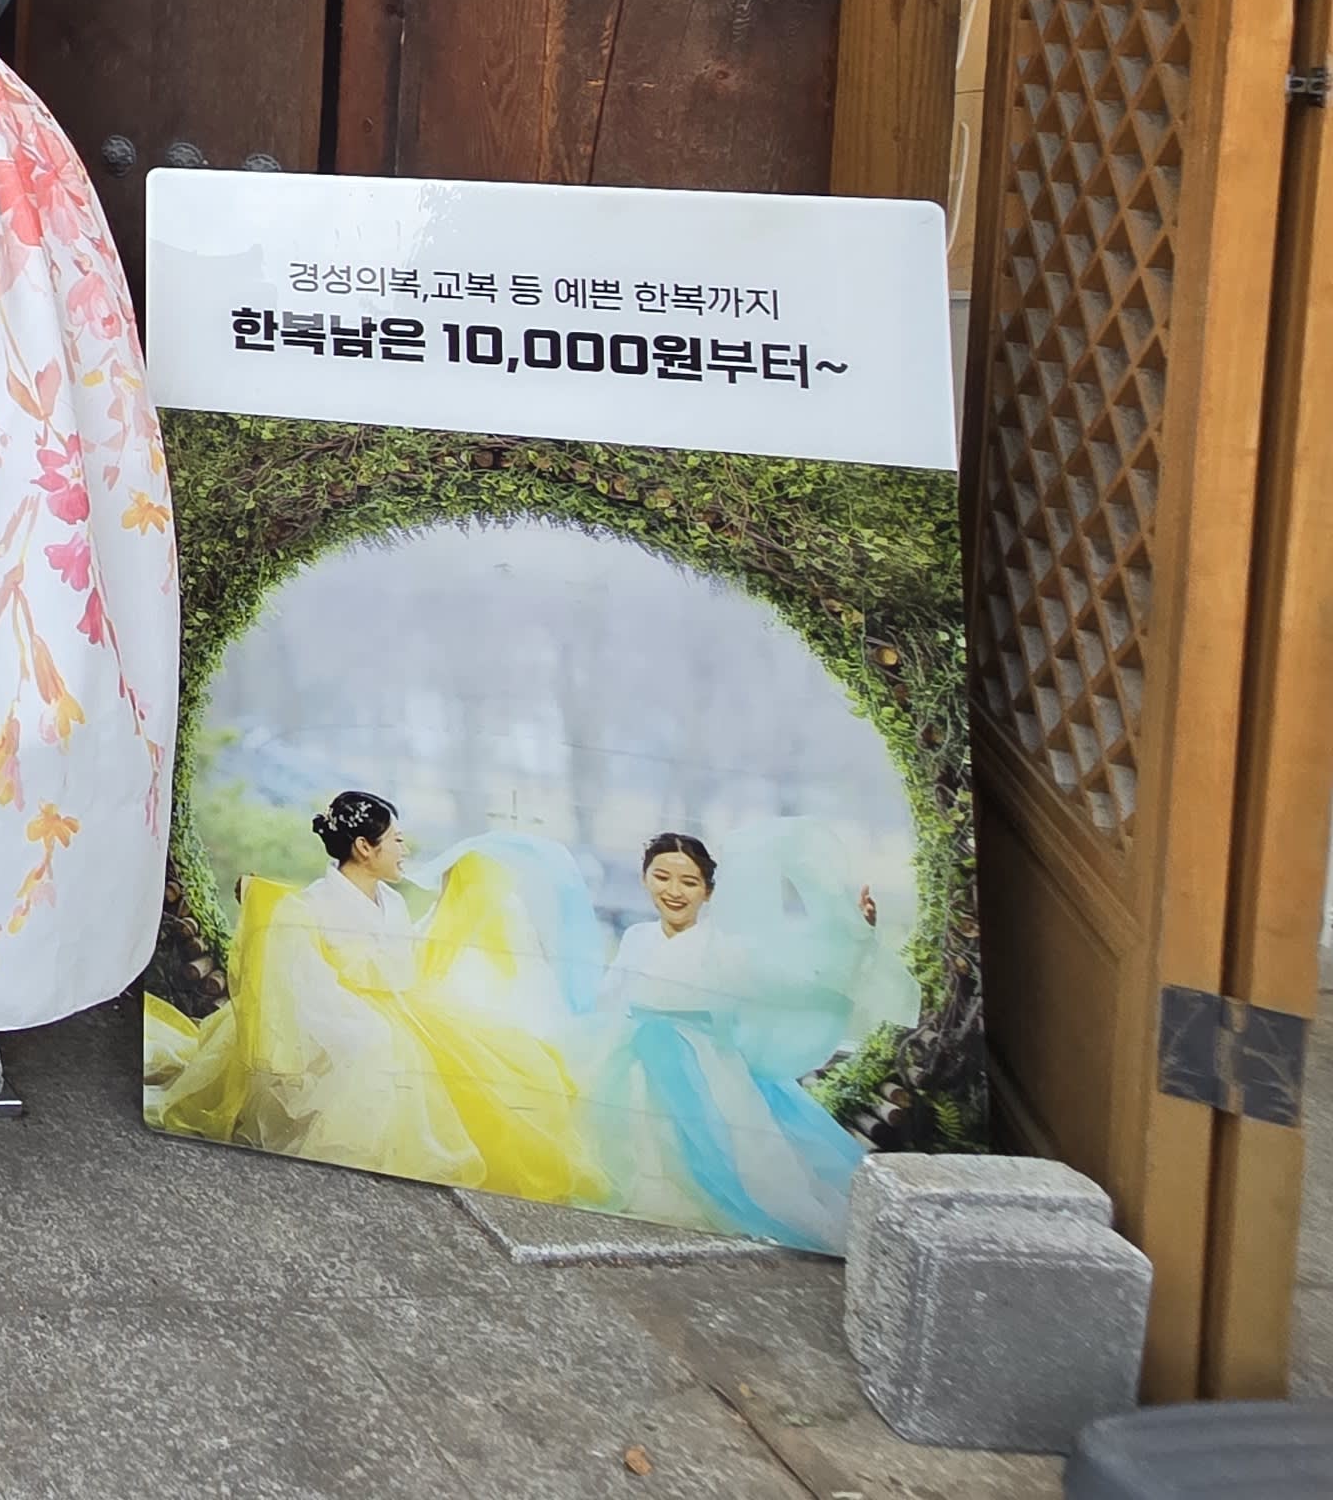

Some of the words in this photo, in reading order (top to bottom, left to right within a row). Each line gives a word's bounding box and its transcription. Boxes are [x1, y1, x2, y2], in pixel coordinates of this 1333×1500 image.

[288, 261, 498, 305] 경성의복,교복
[507, 274, 544, 307] 등
[553, 278, 624, 311] 예쁜
[633, 280, 780, 322] 한복까지
[230, 307, 427, 364] 한복남은
[441, 321, 850, 390] 10,000원부터~
